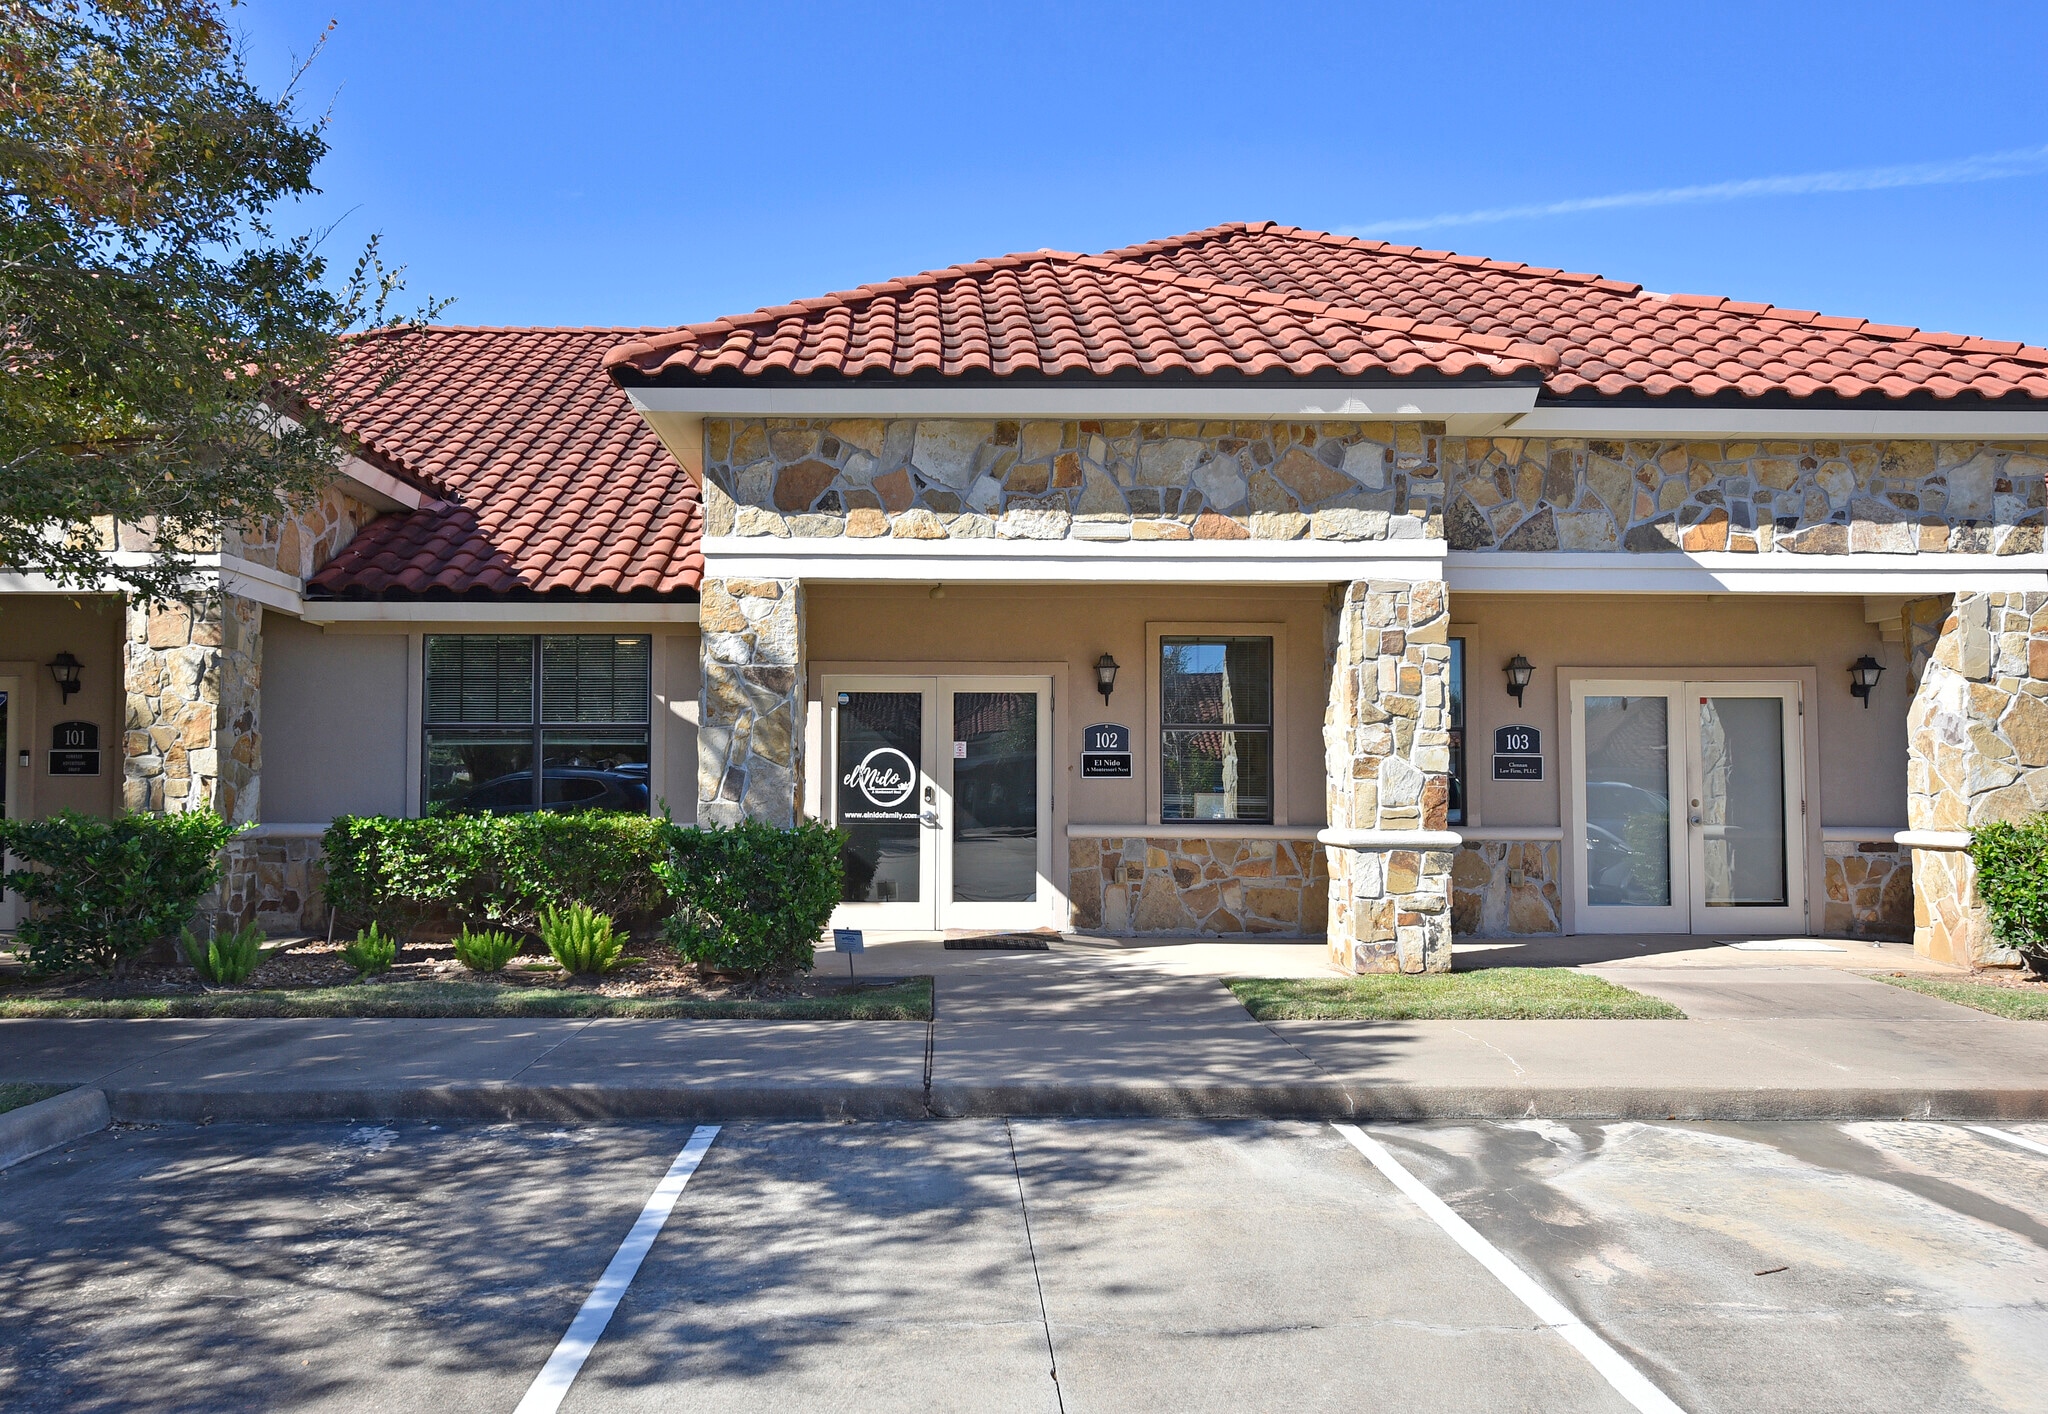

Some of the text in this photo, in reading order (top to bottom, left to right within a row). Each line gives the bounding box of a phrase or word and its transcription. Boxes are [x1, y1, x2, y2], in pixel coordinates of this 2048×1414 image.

[65, 730, 85, 746] 101
[1095, 732, 1118, 748] 102
[1506, 734, 1529, 750] 103
[843, 764, 900, 788] el Nido
